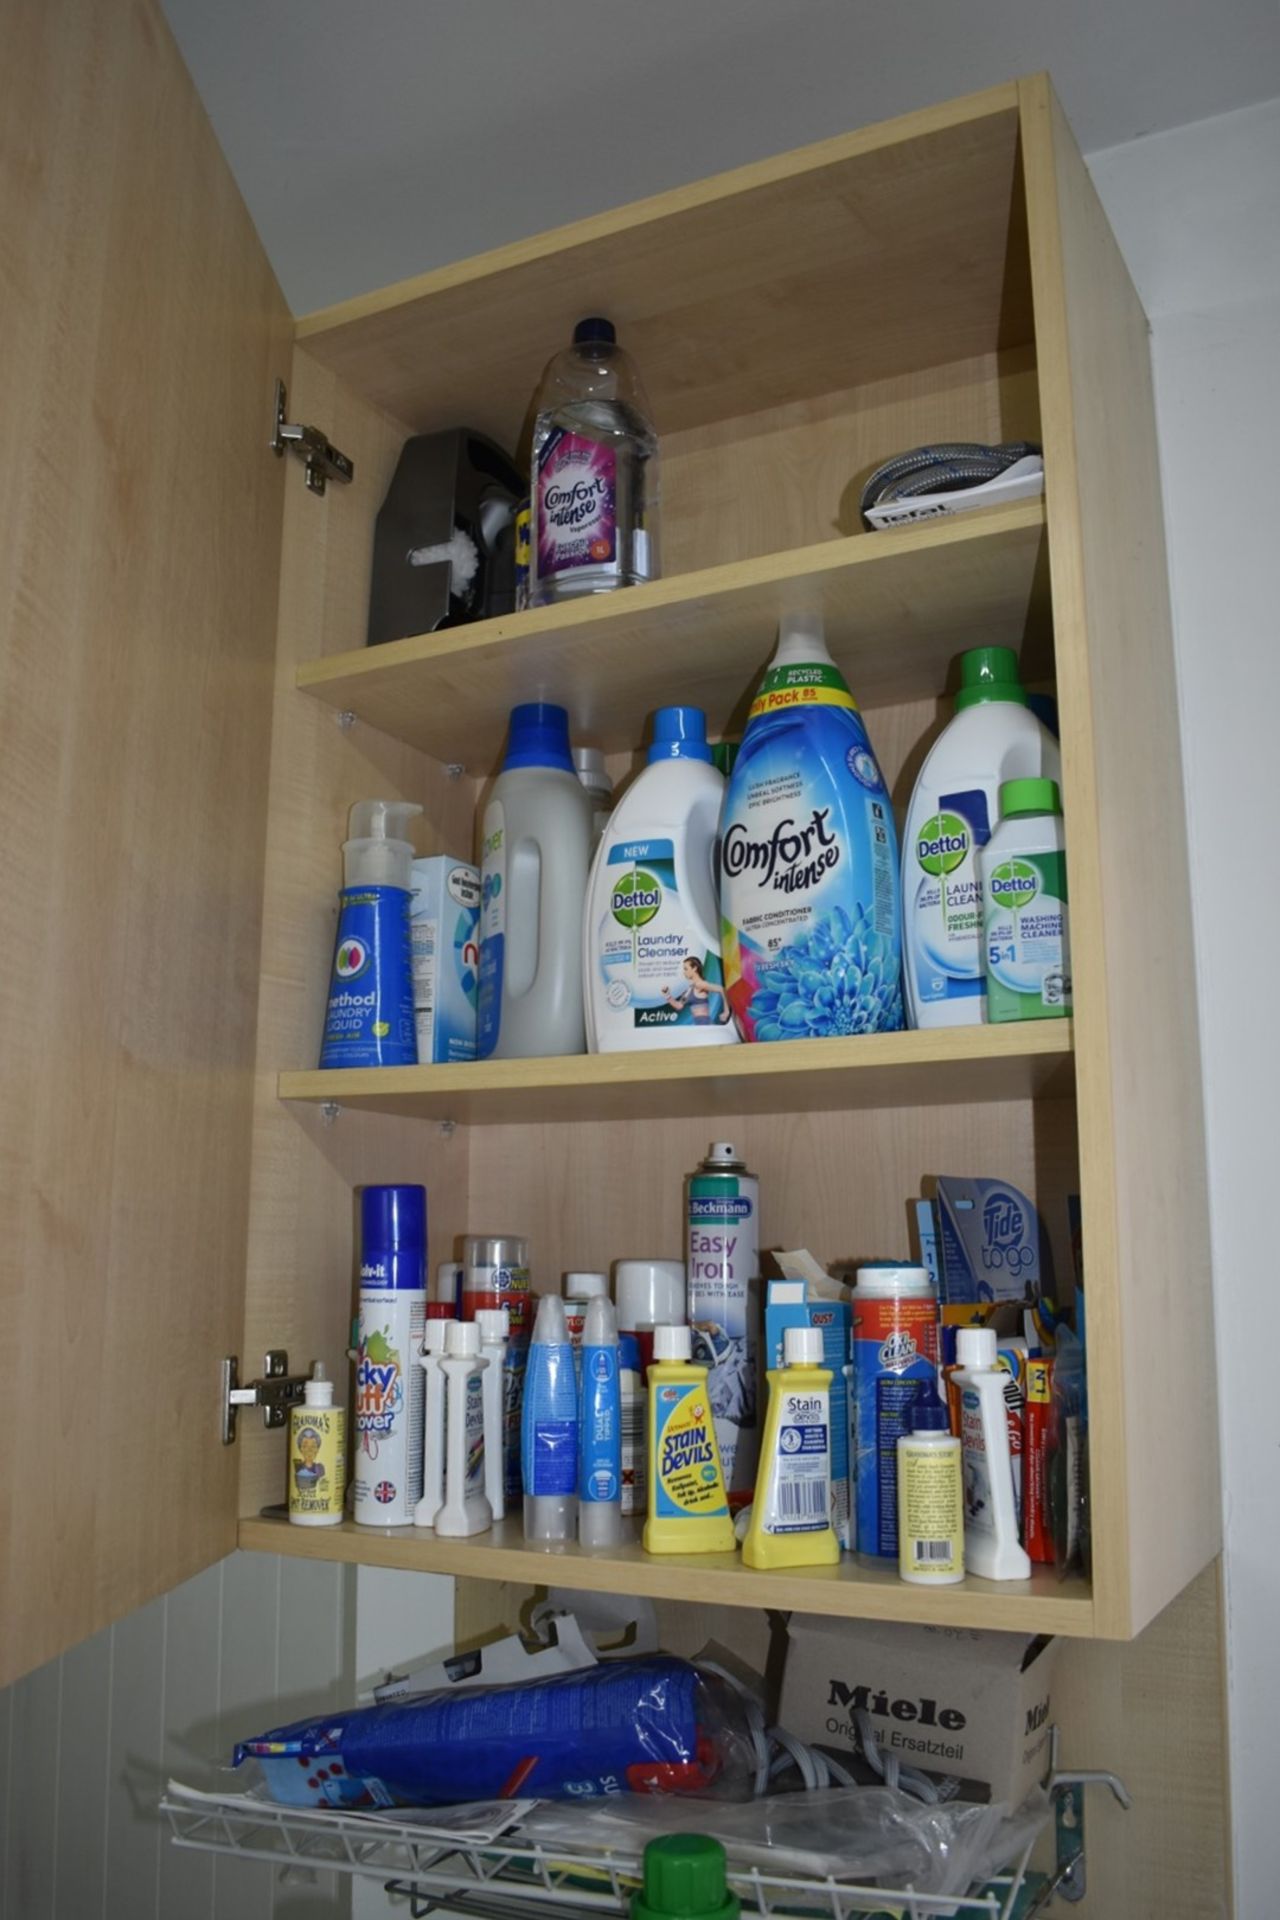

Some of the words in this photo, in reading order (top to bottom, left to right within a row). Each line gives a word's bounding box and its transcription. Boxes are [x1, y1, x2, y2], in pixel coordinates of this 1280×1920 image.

[545, 478, 605, 511] Comfort
[549, 500, 597, 528] intense
[875, 504, 946, 524] Tefal
[786, 675, 823, 684] PLASTIC
[768, 689, 799, 707] Pack
[623, 845, 650, 858] NEW
[723, 808, 835, 888] Comfort
[919, 832, 967, 858] Dettol
[774, 846, 840, 893] intense
[991, 877, 1036, 893] Dettol
[613, 889, 659, 910] Dettol
[763, 906, 812, 921] CONDITIONER
[1020, 914, 1063, 924] WASHING
[1020, 921, 1063, 931] MACHINE
[1020, 929, 1063, 939] CLEANER
[637, 934, 684, 946] Laundry
[637, 946, 689, 958] Cleanser
[638, 1009, 679, 1023] Active
[692, 1202, 748, 1214] Beckmann
[984, 1201, 1023, 1246] Tide
[690, 1231, 737, 1258] Easy
[692, 1257, 734, 1279] Iron
[982, 1245, 1004, 1269] to
[1006, 1245, 1034, 1277] go
[881, 1342, 915, 1361] CLEAN
[788, 1397, 822, 1412] Stain
[827, 1680, 967, 1731] Miele
[826, 1717, 885, 1742] Origal
[890, 1731, 965, 1760] Ersatzteil
